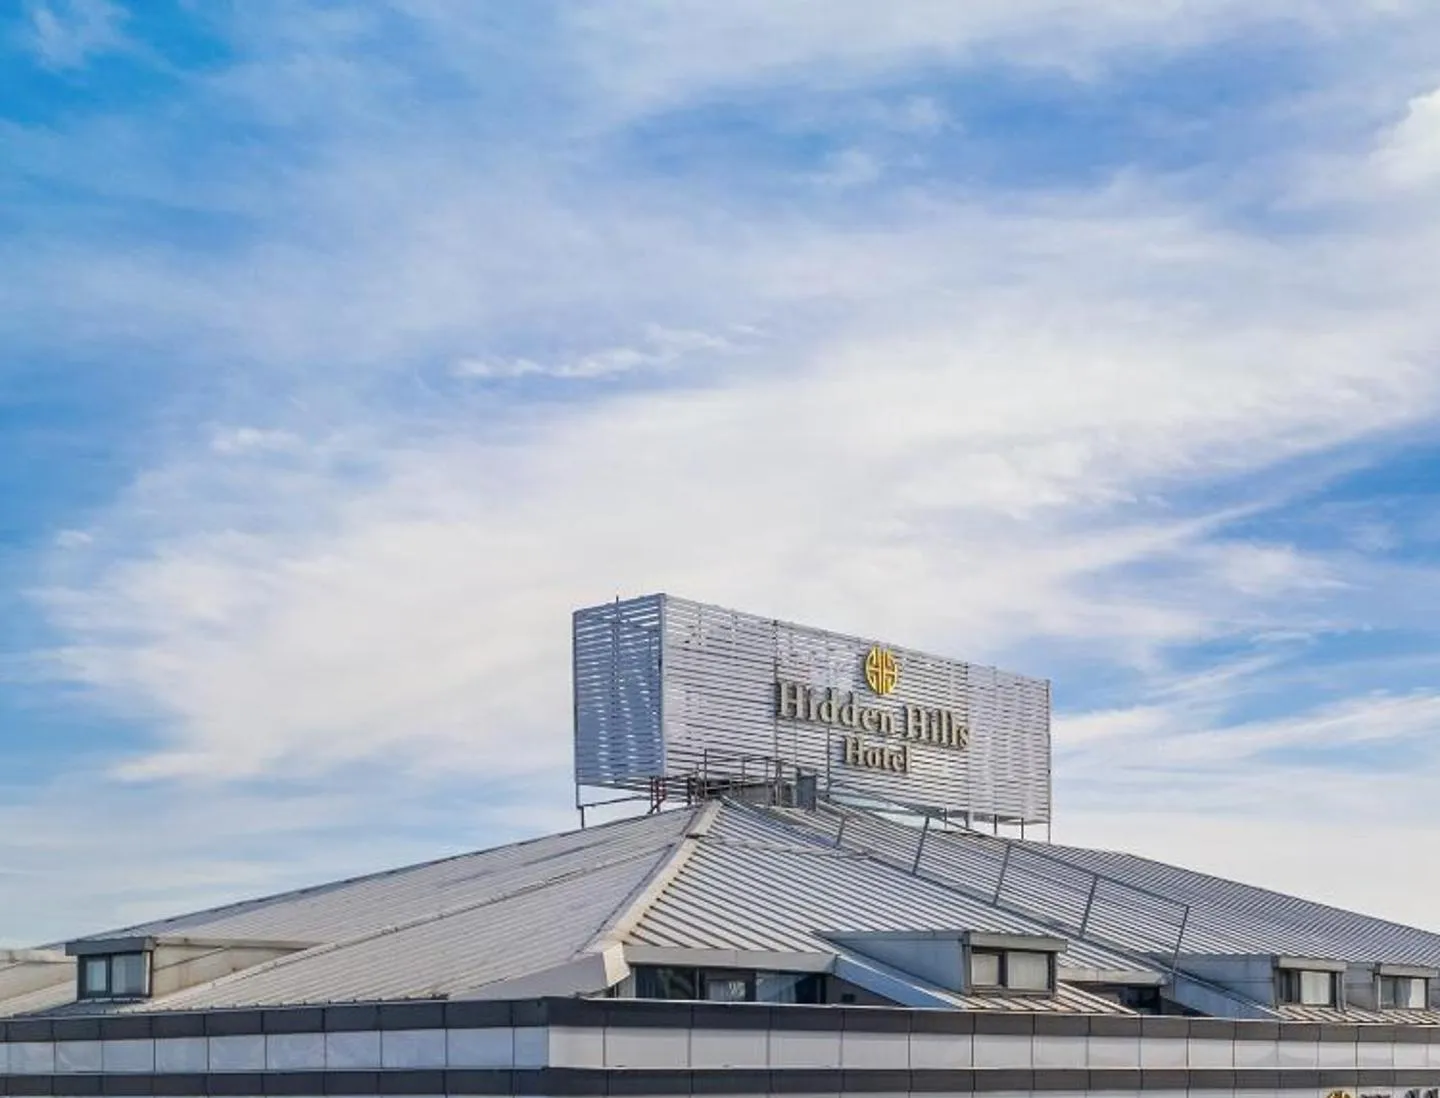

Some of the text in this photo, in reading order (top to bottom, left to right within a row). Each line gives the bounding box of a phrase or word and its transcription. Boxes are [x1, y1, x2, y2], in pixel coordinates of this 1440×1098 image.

[777, 681, 969, 749] Hidden Hills
[844, 734, 911, 773] Hotel
